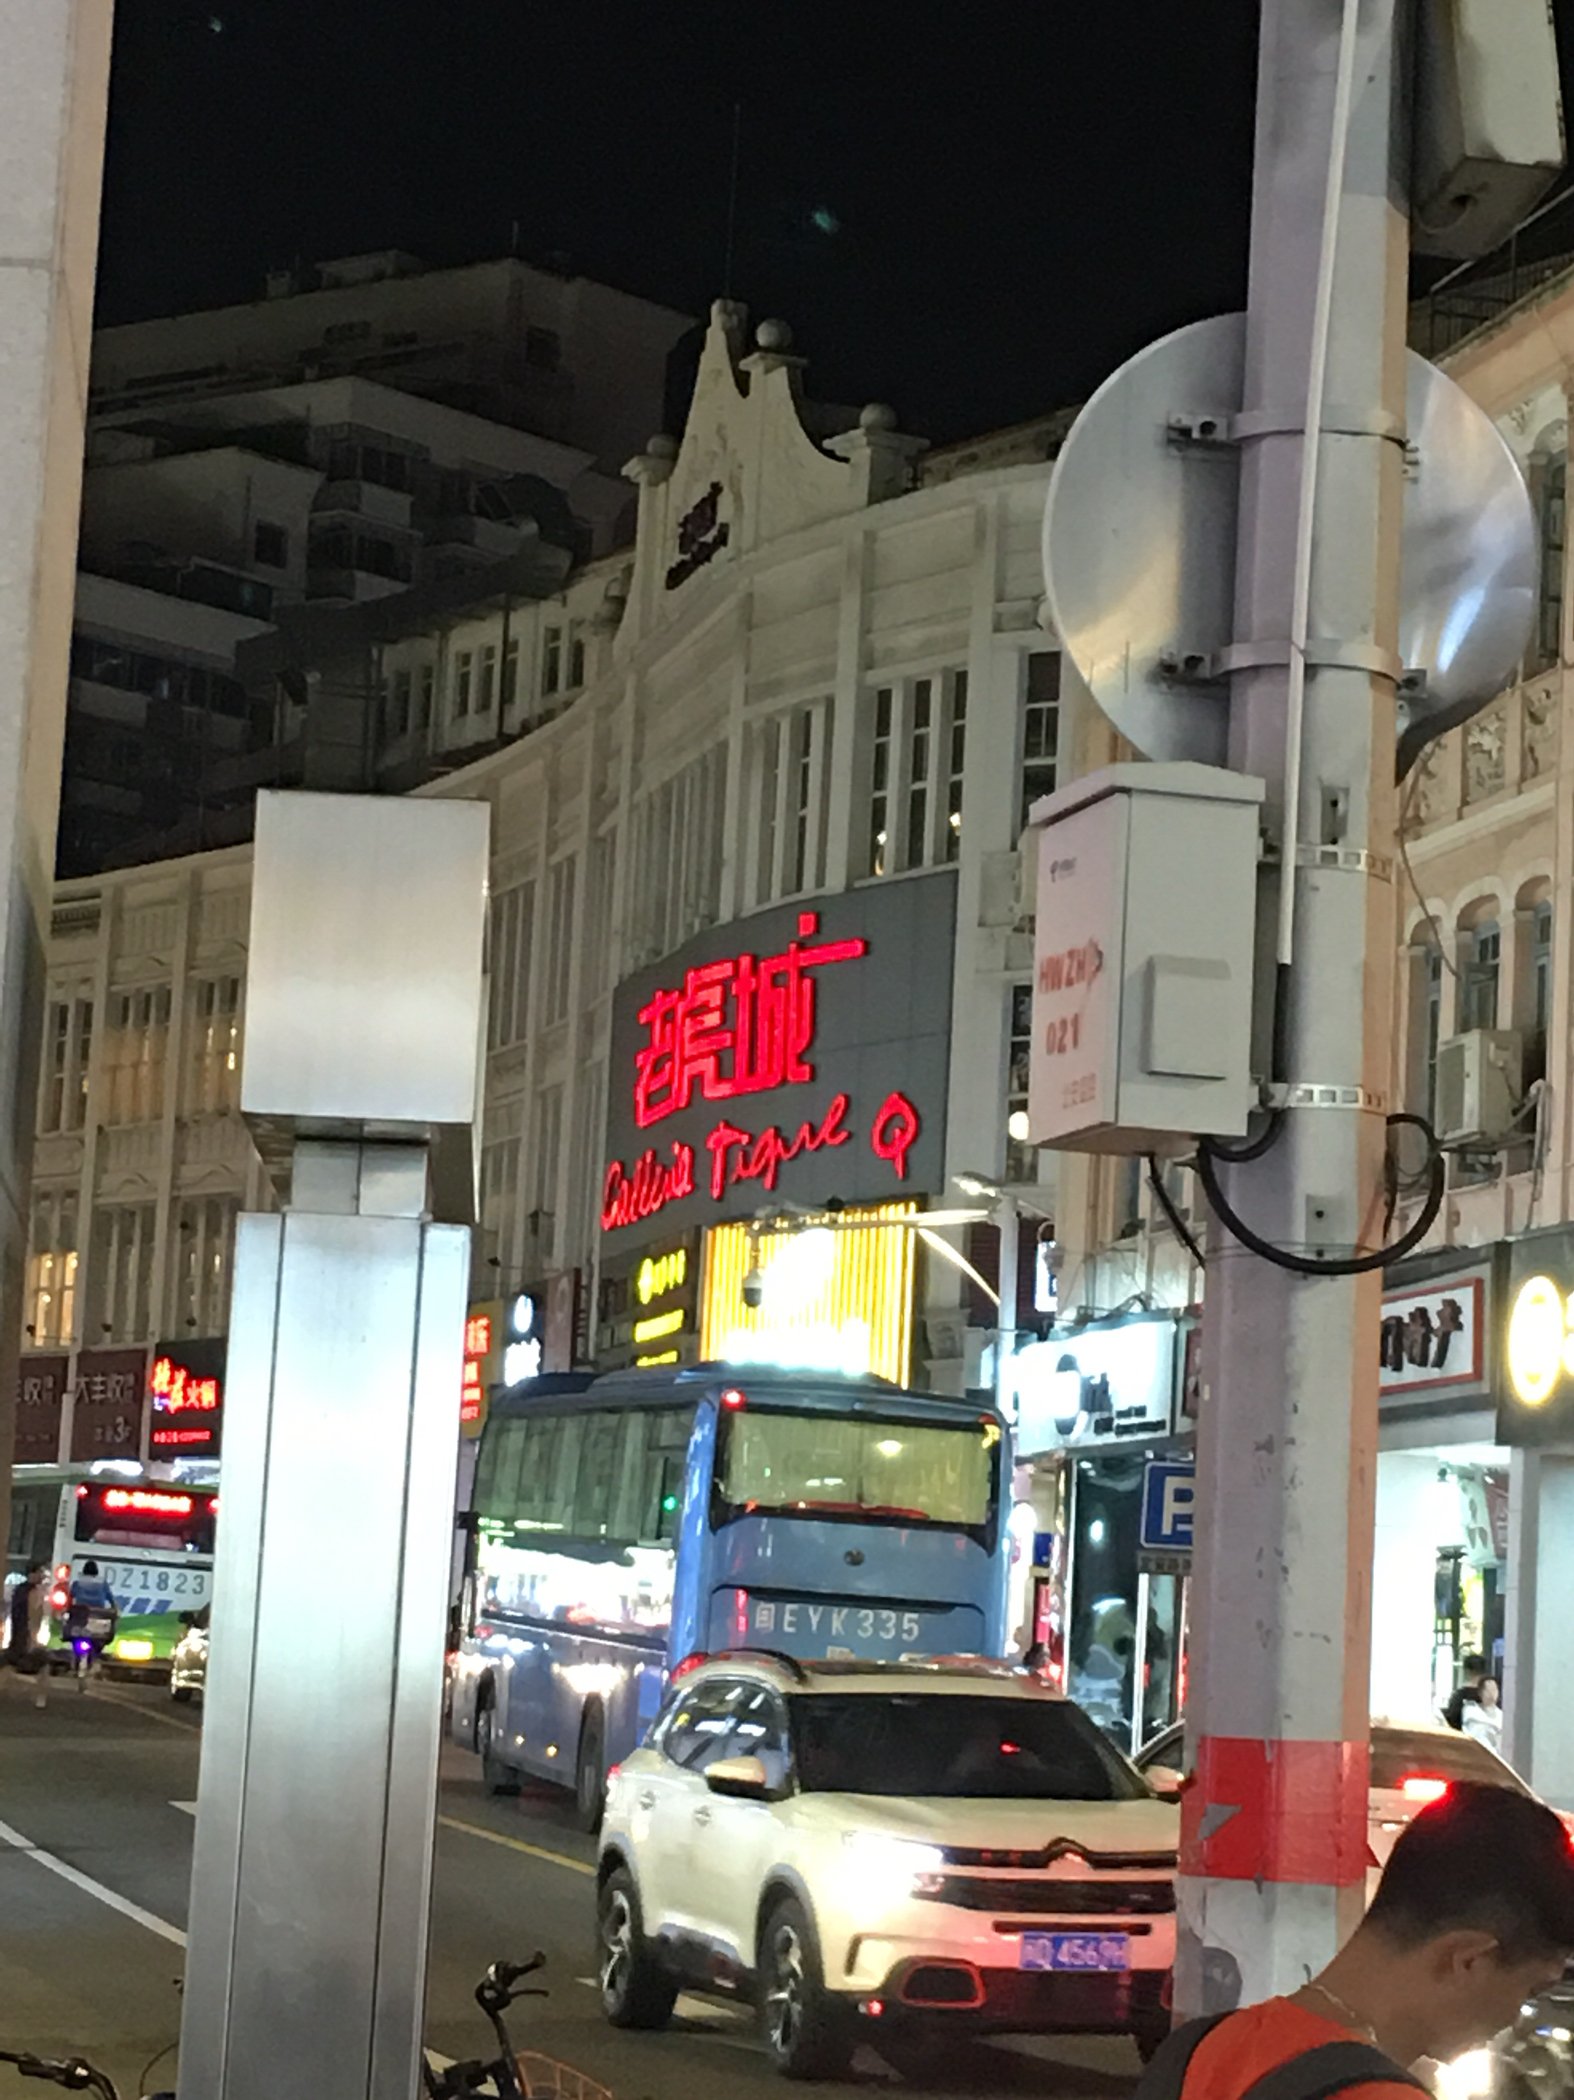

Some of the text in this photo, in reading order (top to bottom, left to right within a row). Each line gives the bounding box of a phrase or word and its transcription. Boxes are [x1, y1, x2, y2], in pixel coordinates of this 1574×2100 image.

[1045, 1013, 1080, 1055] 021
[869, 1091, 918, 1181] Q
[102, 1566, 206, 1595] DZ1823
